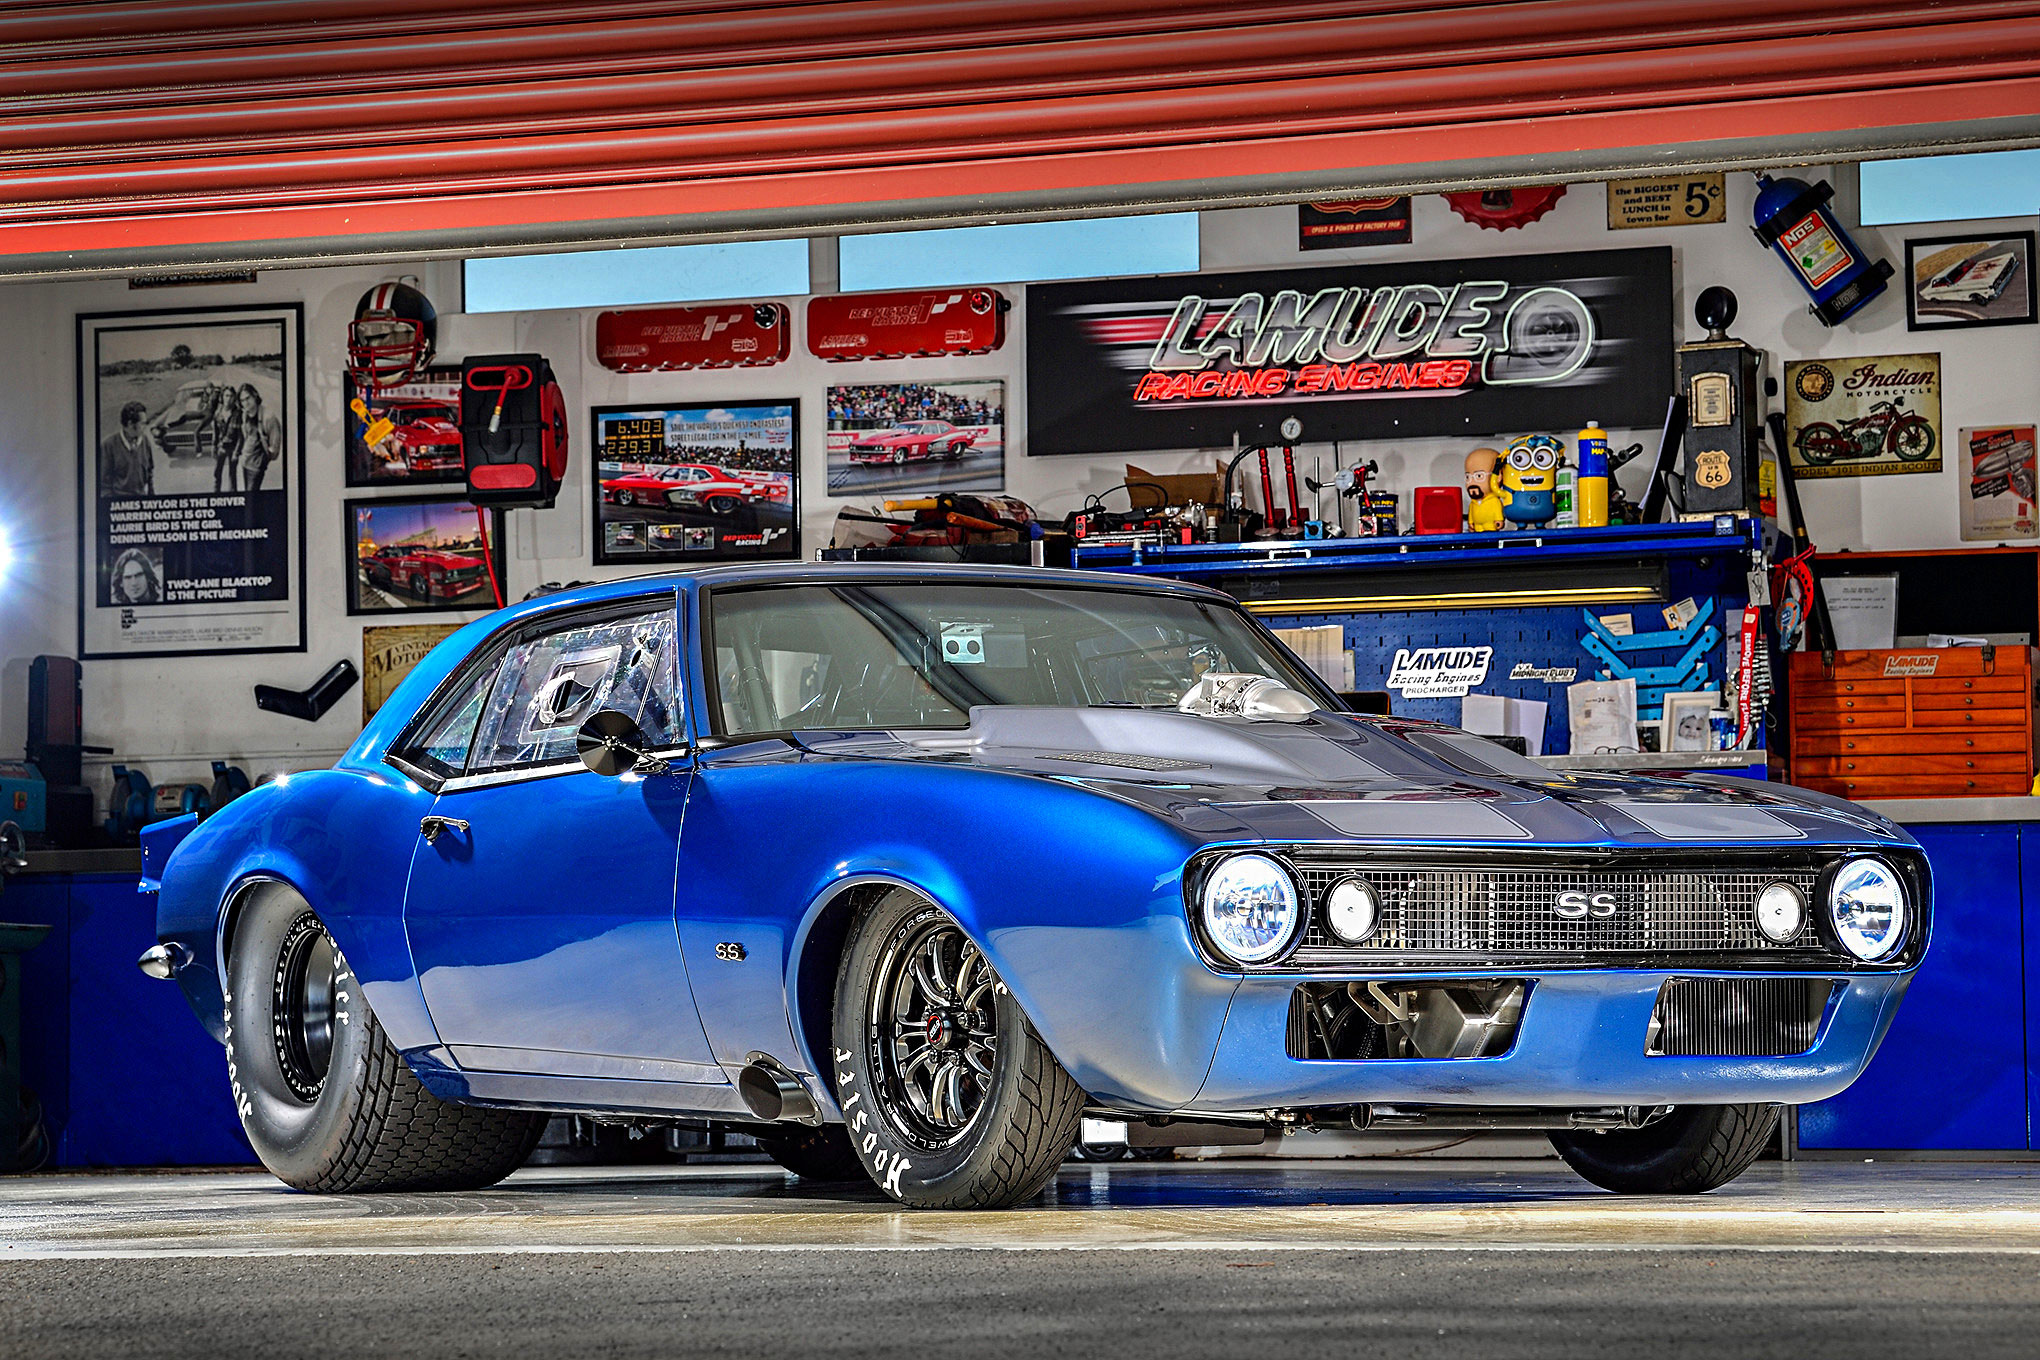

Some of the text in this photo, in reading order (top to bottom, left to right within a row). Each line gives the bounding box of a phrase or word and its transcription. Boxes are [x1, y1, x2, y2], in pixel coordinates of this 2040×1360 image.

[1634, 184, 1680, 194] BIGGEST
[1645, 195, 1671, 203] BEST
[1623, 205, 1658, 214] LUNCH
[1335, 224, 1354, 232] POWER
[1363, 221, 1387, 230] FACTORY
[1784, 216, 1815, 245] NOS
[1150, 280, 1509, 371] LAMUDE
[1133, 359, 1473, 400] RACING ENGINES
[1842, 363, 1936, 391] Indian
[1846, 387, 1932, 398] MOTORCYCLE
[618, 419, 661, 434] 6.403
[607, 439, 662, 455] 229.31
[1861, 463, 1899, 473] INDIAN
[1706, 471, 1723, 483] 66
[110, 496, 246, 511] JAMES TAYLOR IS THE DRIVER
[110, 508, 215, 522] WARREN OATES IS GTO
[110, 519, 223, 533] LAURIE BIRD IS THE GIRL
[110, 528, 268, 544] DENNIS WILSON IS THE MECHANIC
[167, 576, 272, 590] TWO-LANE BLACKTOP
[167, 588, 237, 601] IS THE PICTURE
[1669, 612, 1677, 622] R
[1742, 632, 1754, 667] REMOVE
[1396, 651, 1488, 671] LAMUDE
[1888, 657, 1937, 668] LAMUDE
[1391, 671, 1481, 686] Racing Engines
[1740, 668, 1752, 700] BEFORE
[1405, 686, 1466, 694] PROCHARGER
[1554, 891, 1617, 919] SS
[715, 942, 739, 960] SS
[871, 1024, 895, 1115] RACING
[908, 1132, 949, 1149] WELD
